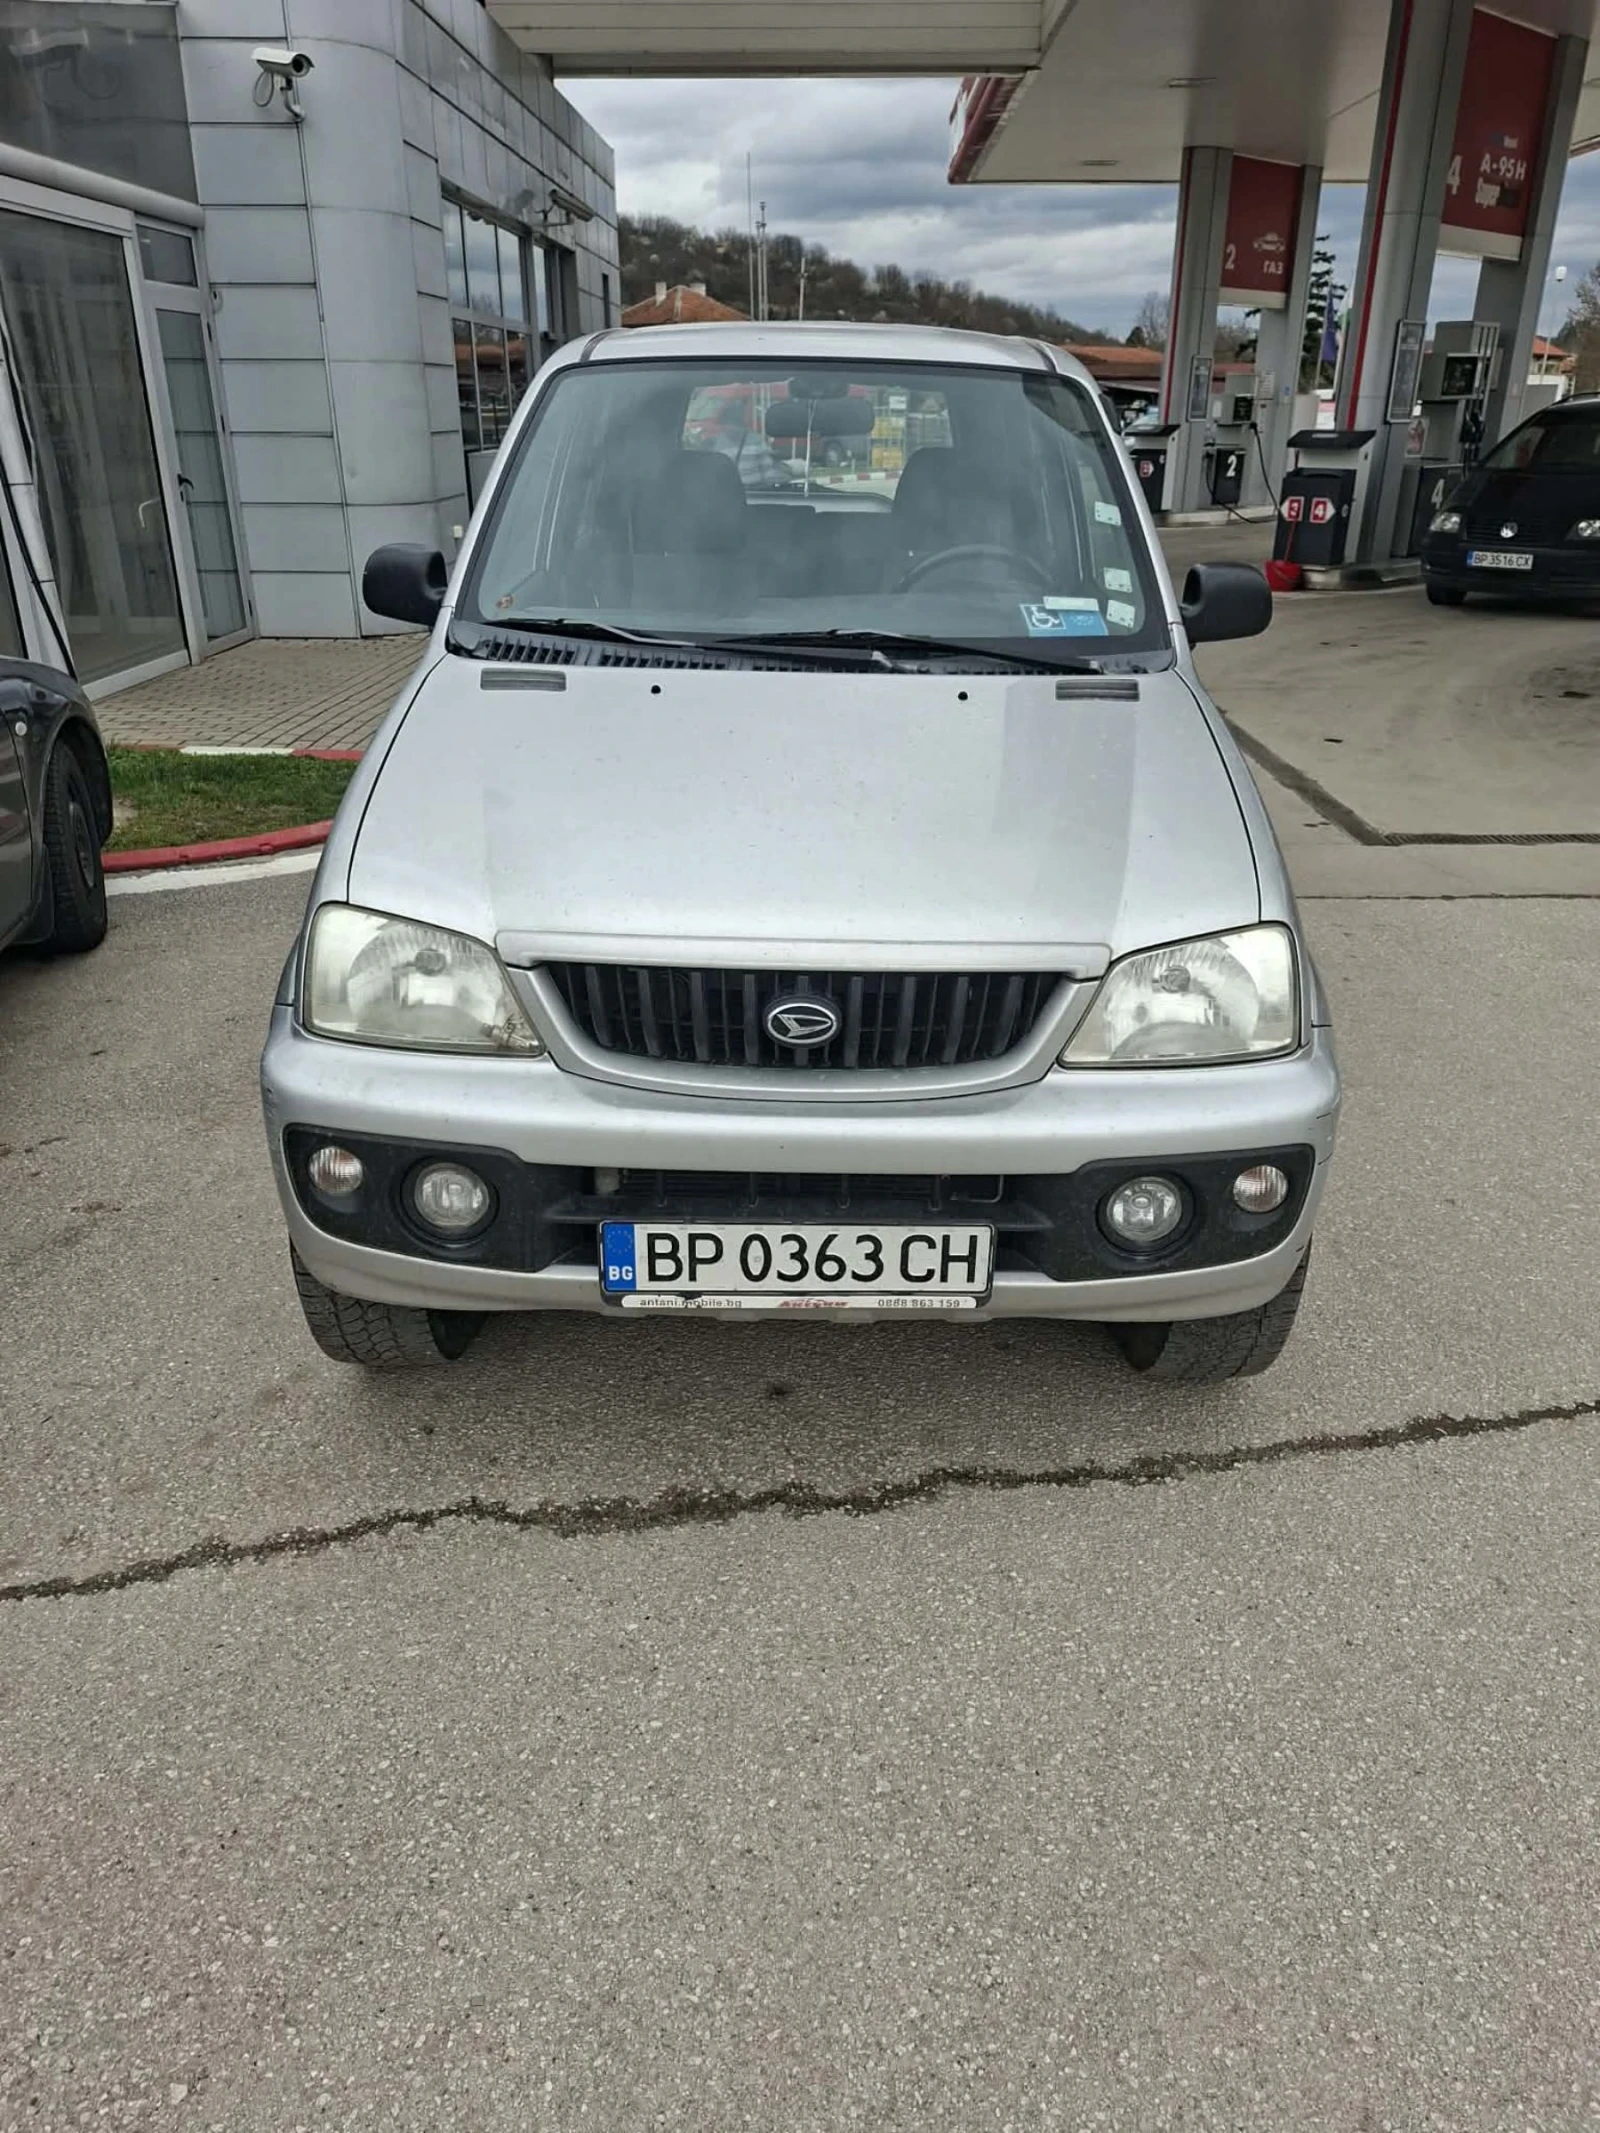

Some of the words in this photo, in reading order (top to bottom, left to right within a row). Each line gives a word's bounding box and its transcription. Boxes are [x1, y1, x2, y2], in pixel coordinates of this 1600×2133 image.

[1446, 154, 1462, 195] 4
[1224, 243, 1237, 270] 2
[1263, 260, 1284, 275] ГАЗ
[1226, 455, 1237, 477] 2
[1431, 479, 1445, 510] 4
[1289, 501, 1299, 517] 3
[1314, 503, 1325, 518] 4
[646, 1232, 725, 1283] BP
[739, 1233, 885, 1283] 0363
[900, 1234, 977, 1283] CH
[608, 1266, 633, 1281] BG
